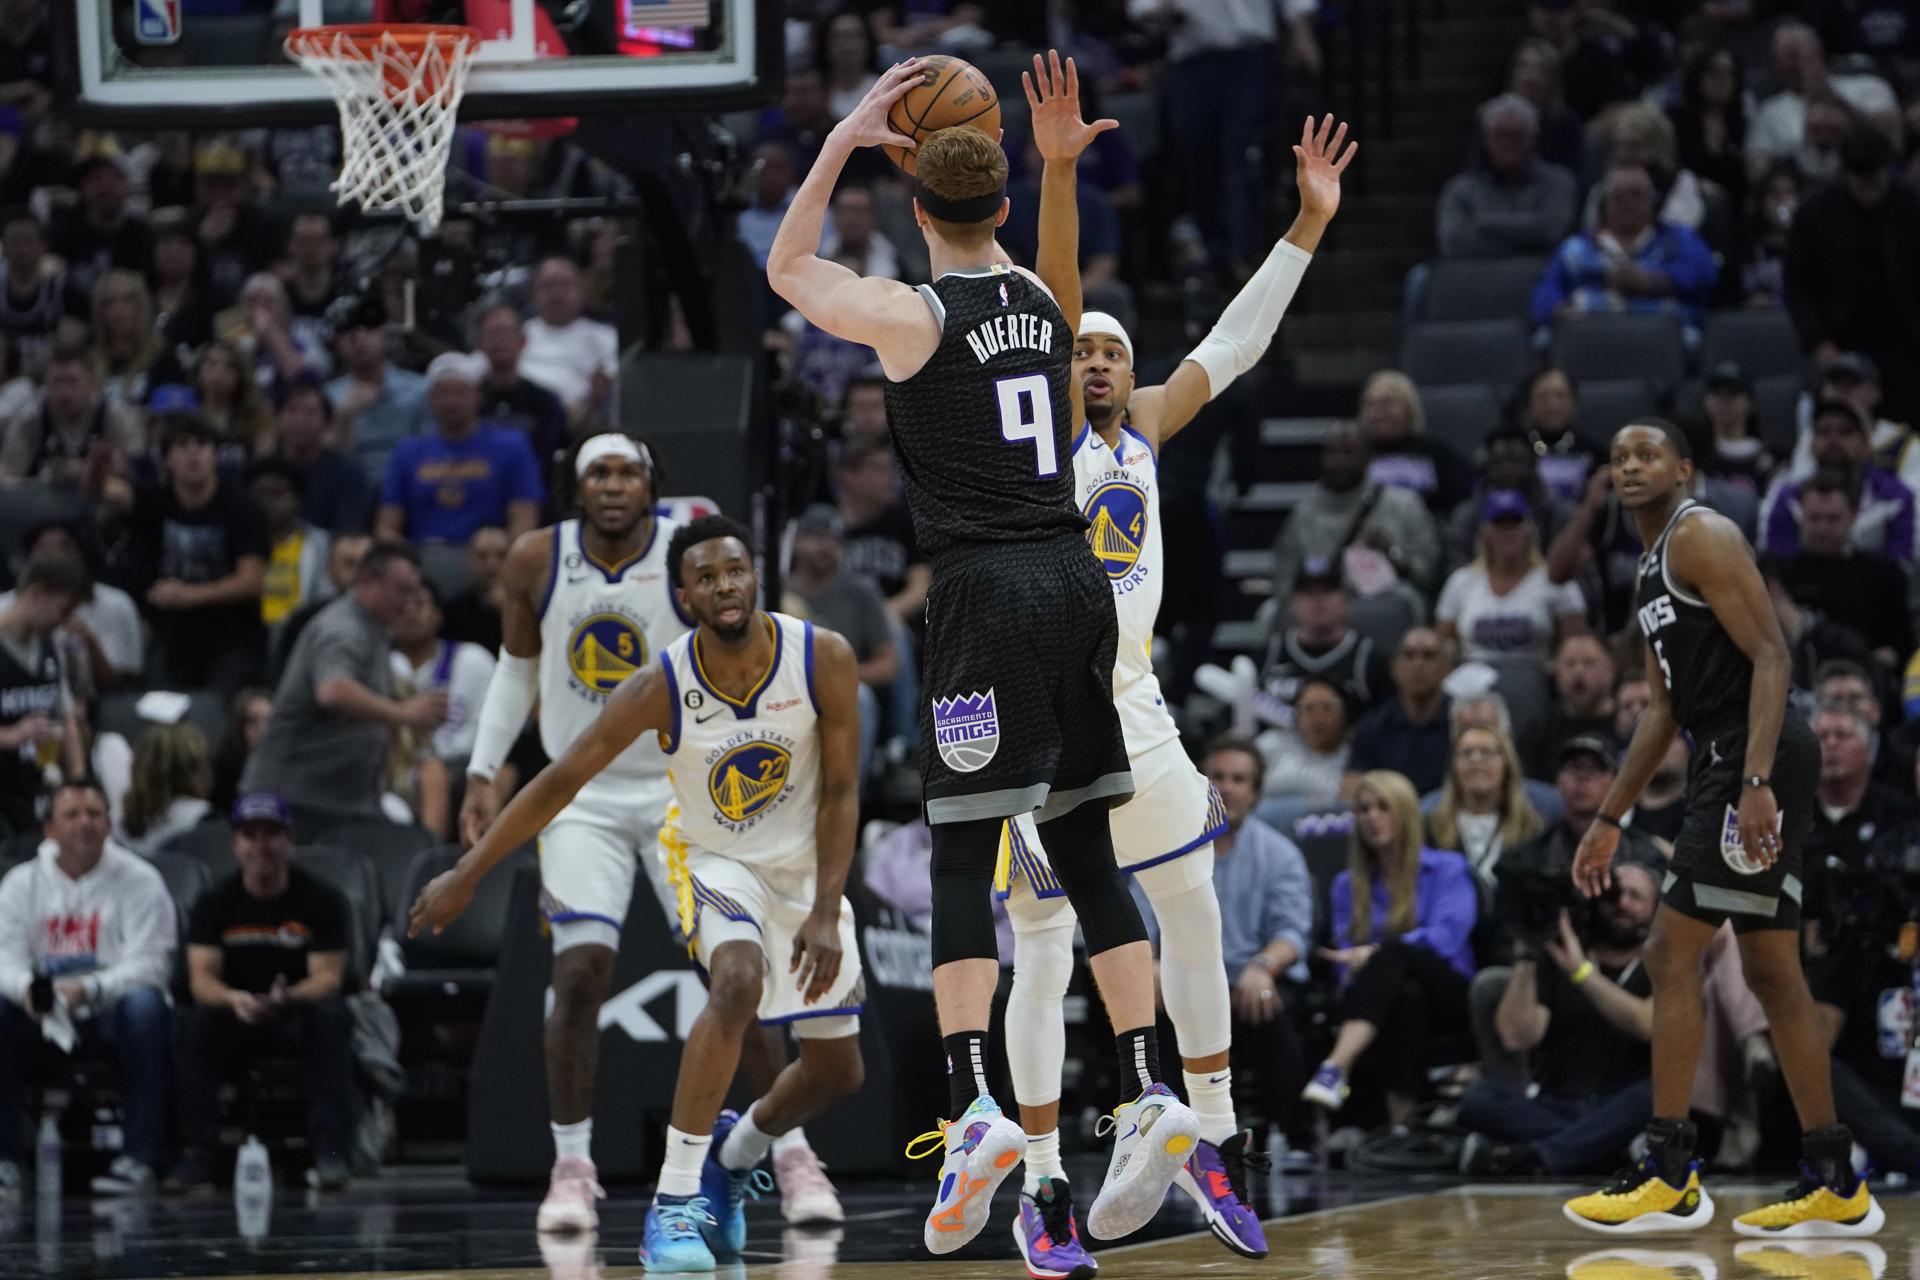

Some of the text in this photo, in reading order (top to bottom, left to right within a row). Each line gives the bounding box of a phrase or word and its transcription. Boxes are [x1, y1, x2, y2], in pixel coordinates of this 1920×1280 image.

[966, 313, 1053, 364] HUERTER
[994, 372, 1059, 478] 9
[1086, 470, 1130, 494] GOLDEN
[1129, 512, 1142, 538] 4
[618, 632, 634, 658] 5
[687, 690, 702, 708] 6
[937, 711, 993, 727] SACRAMENTO
[937, 720, 997, 745] KINGS
[705, 730, 796, 765] GOLDEN STATE
[759, 755, 787, 782] 22
[714, 784, 795, 833] WARRIORS
